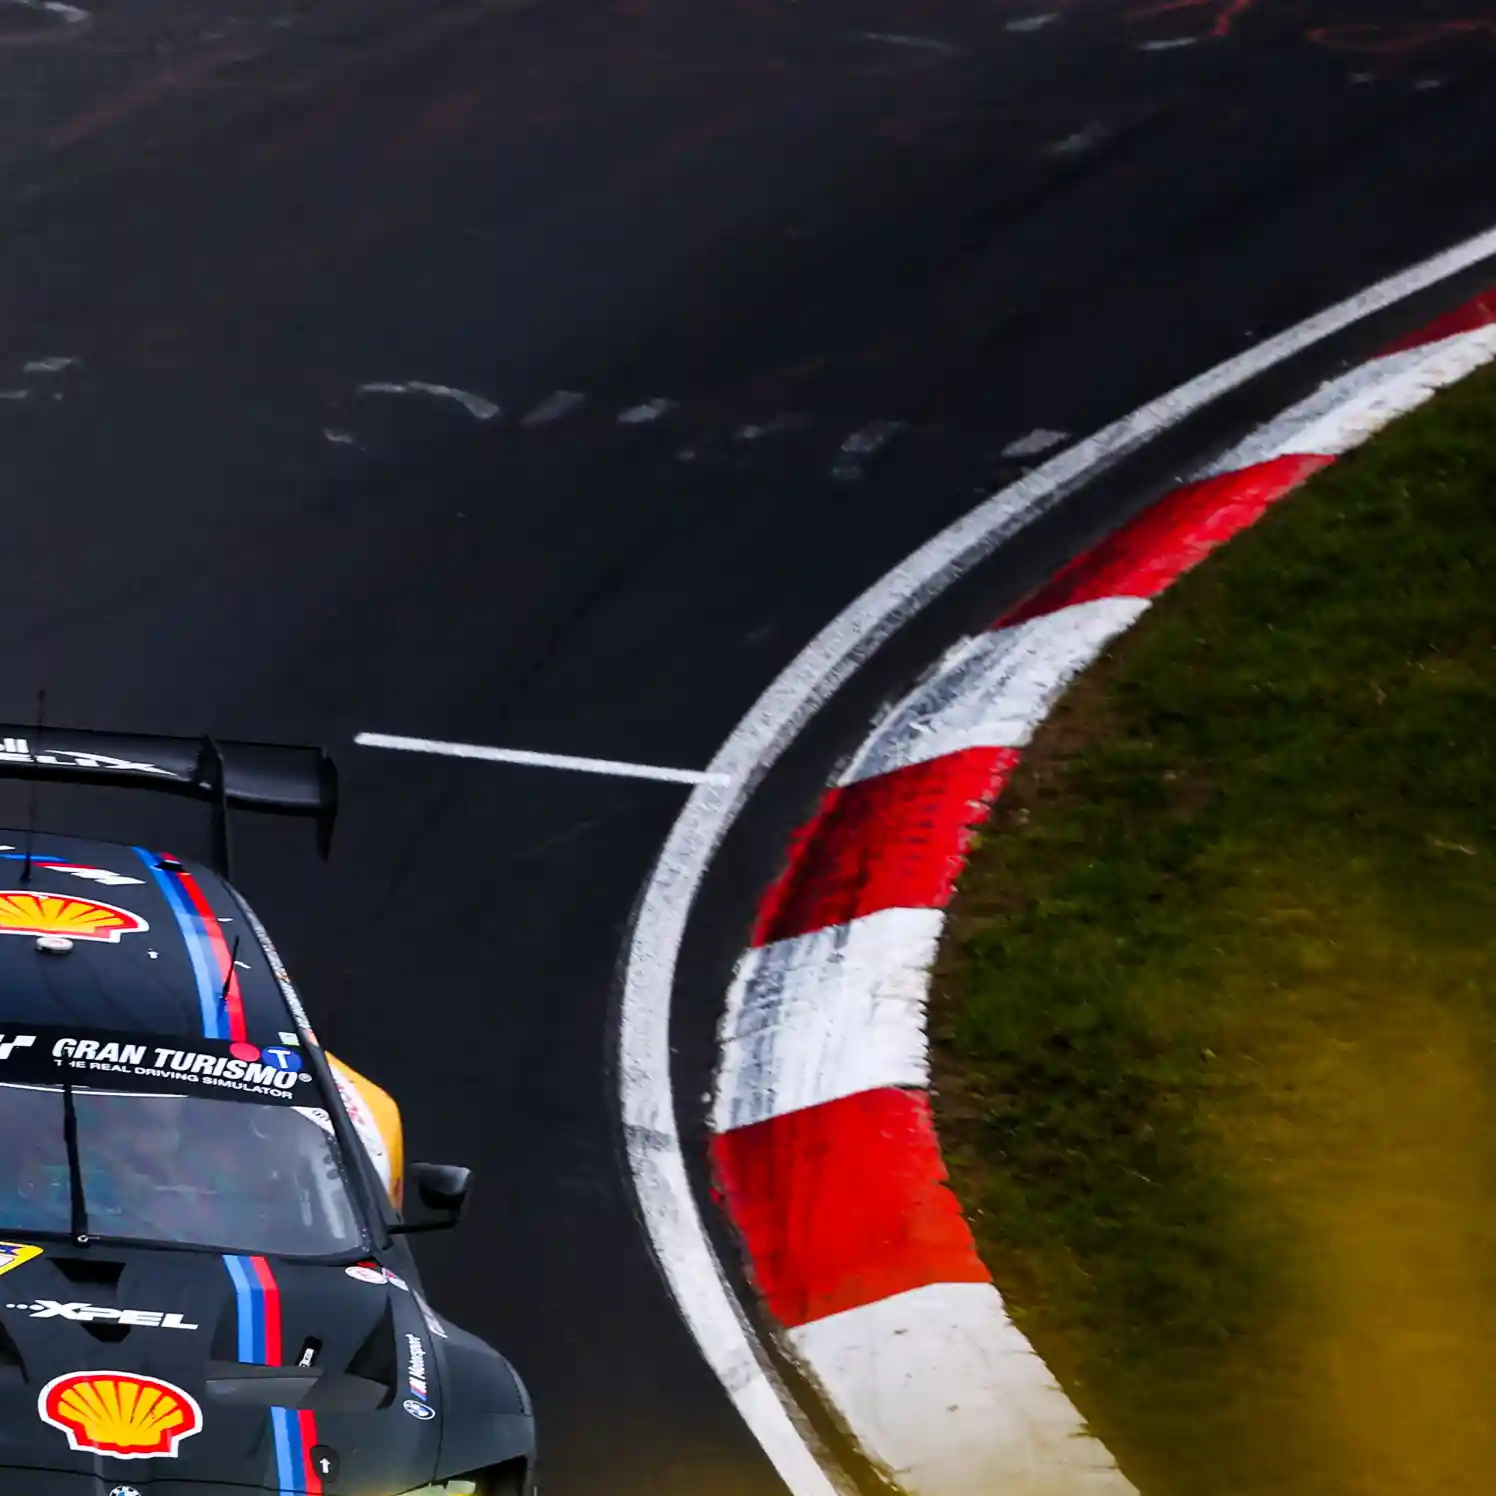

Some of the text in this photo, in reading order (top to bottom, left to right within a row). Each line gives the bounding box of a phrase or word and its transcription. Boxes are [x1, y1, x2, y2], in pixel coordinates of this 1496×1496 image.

[51, 1038, 299, 1089] GRAN TURISMO
[267, 1049, 292, 1069] T
[89, 1062, 132, 1074] REAL
[134, 1066, 200, 1083] DRIVING
[201, 1076, 294, 1100] SIMULATOR
[29, 1299, 199, 1330] XPEL
